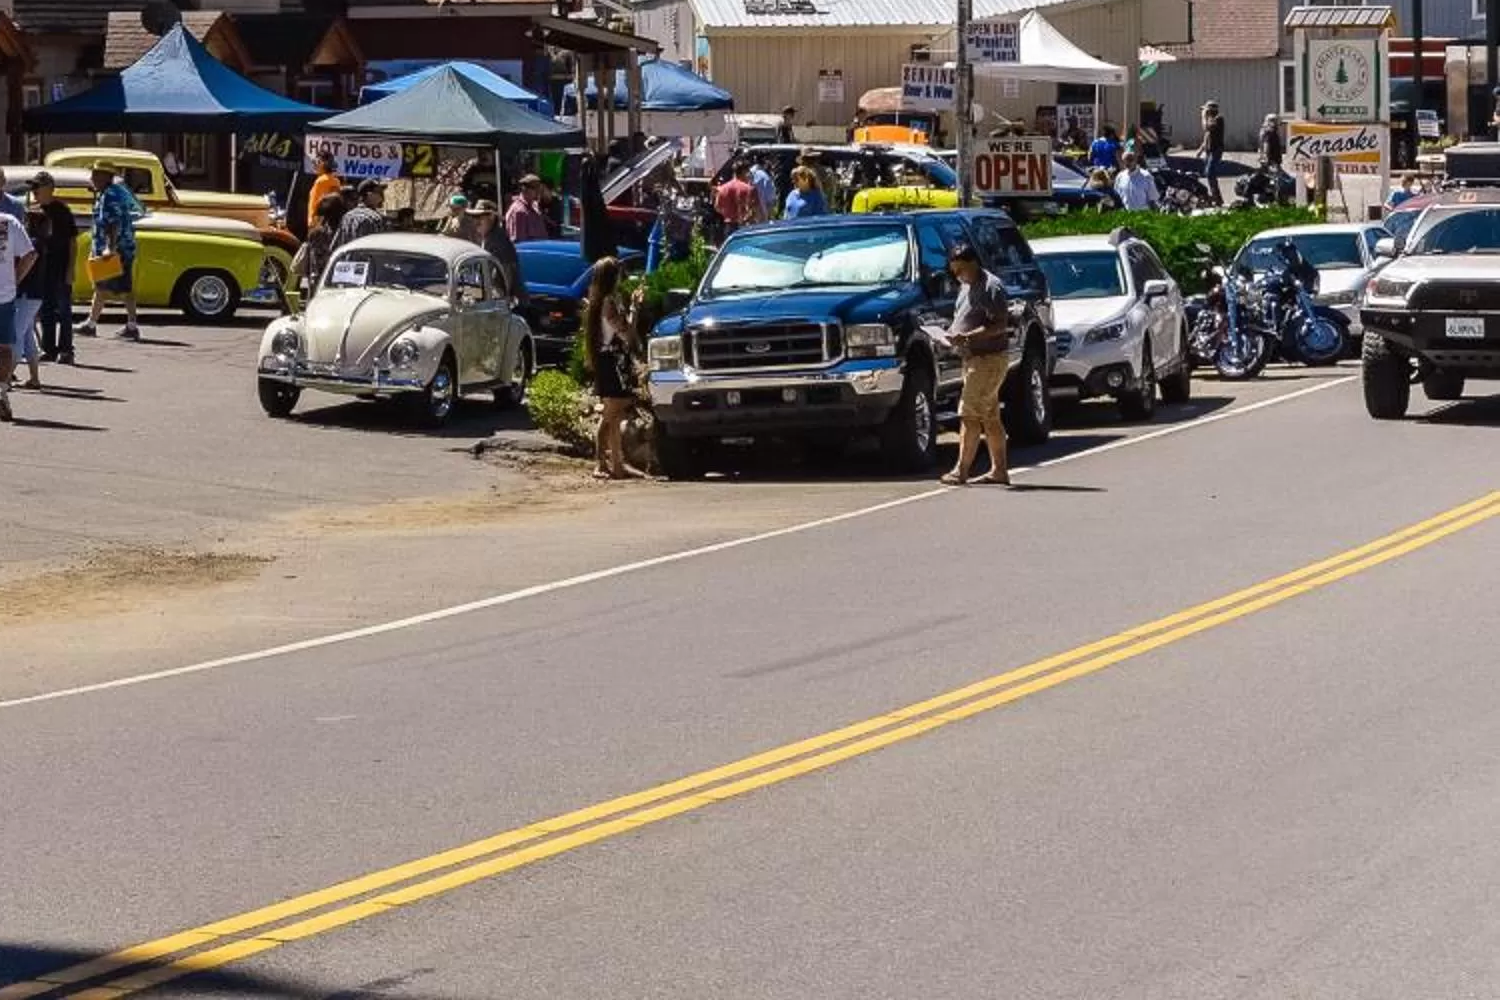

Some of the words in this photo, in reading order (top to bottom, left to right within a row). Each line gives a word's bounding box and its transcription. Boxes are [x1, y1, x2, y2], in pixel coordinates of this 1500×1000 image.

[309, 140, 342, 156] HOT
[347, 143, 382, 159] DOG
[988, 141, 1033, 152] WE'RE
[1290, 128, 1377, 160] Karaoke
[344, 160, 391, 175] Water
[976, 154, 1047, 191] OPEN
